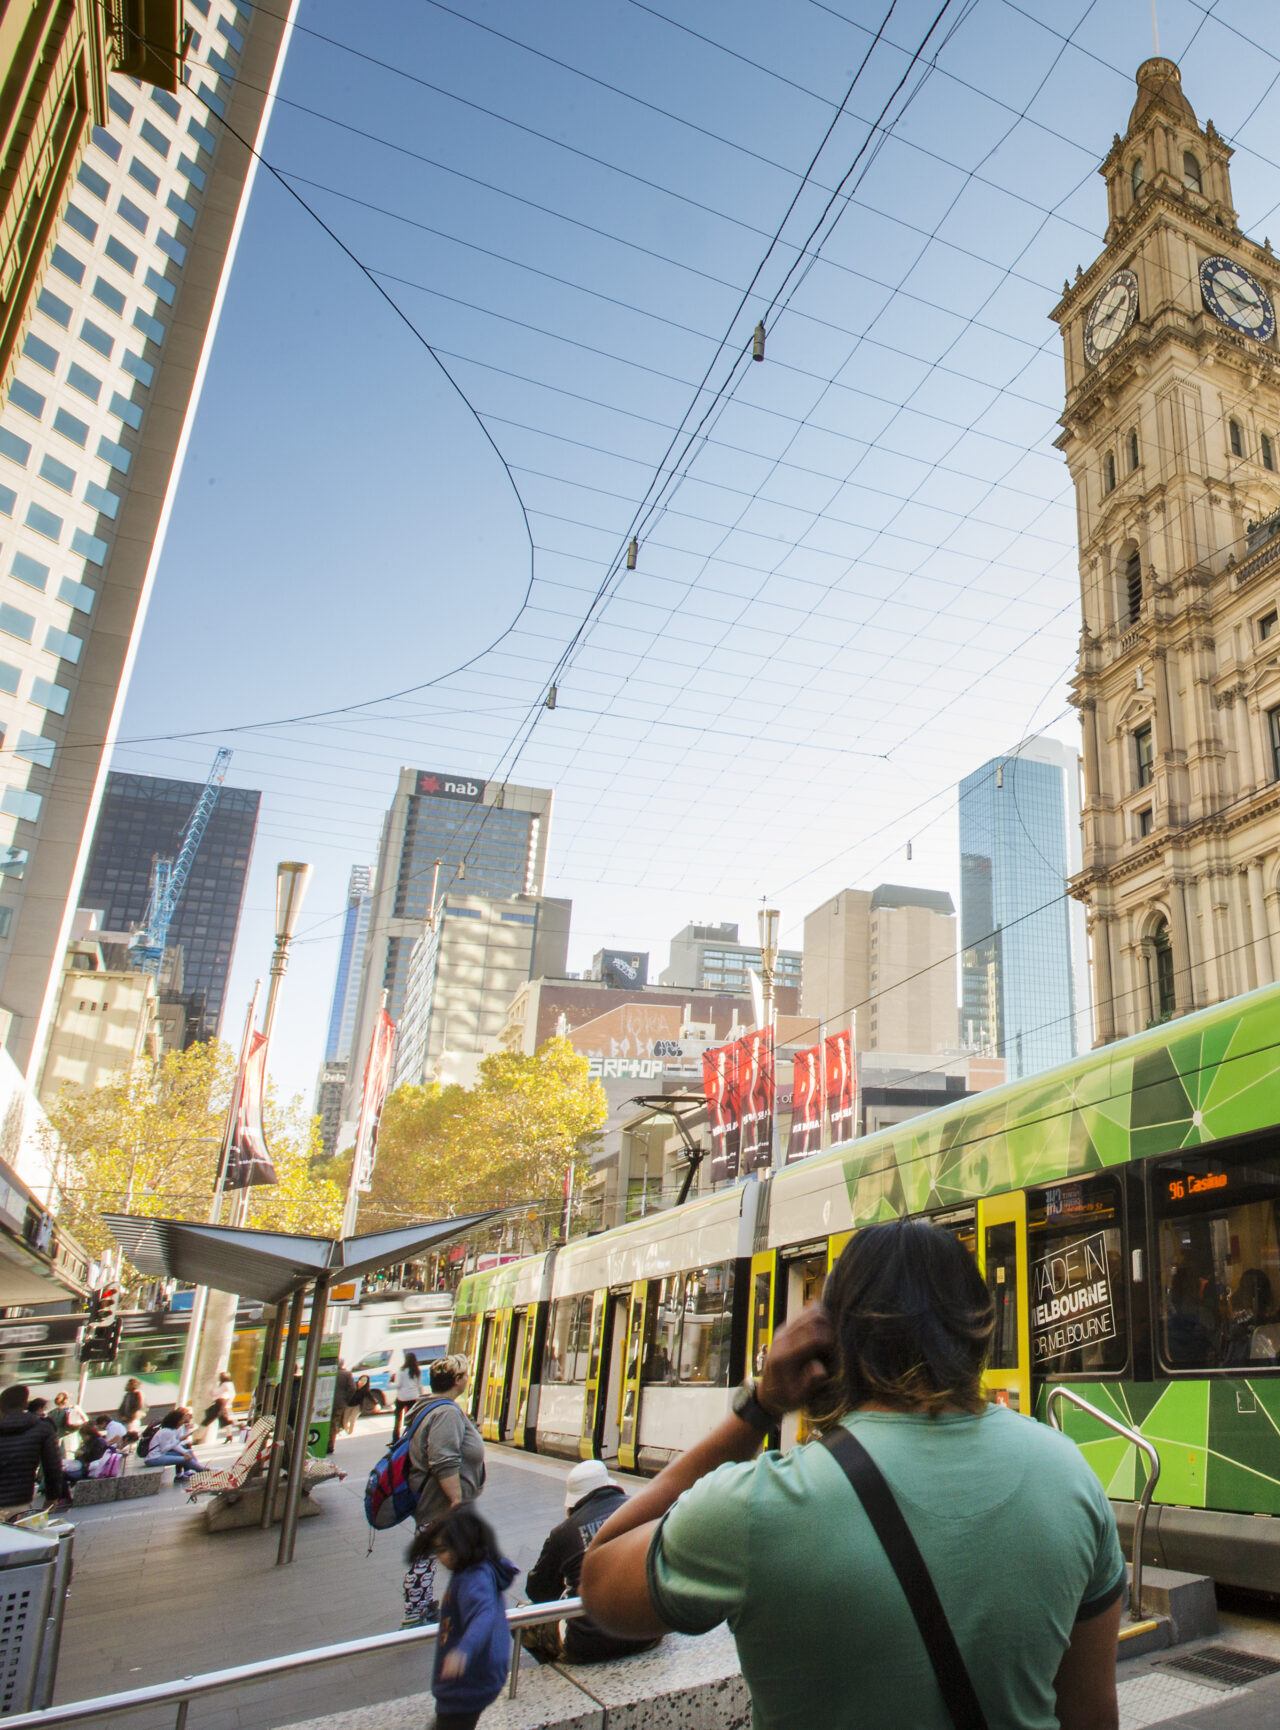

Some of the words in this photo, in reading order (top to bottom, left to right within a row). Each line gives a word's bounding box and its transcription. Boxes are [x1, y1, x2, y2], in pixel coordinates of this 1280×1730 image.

[444, 782, 479, 796] nab
[1169, 1180, 1185, 1200] 96
[1187, 1173, 1228, 1194] Casino
[1084, 1239, 1105, 1280] IN
[1049, 1312, 1111, 1351] MELBOURNE
